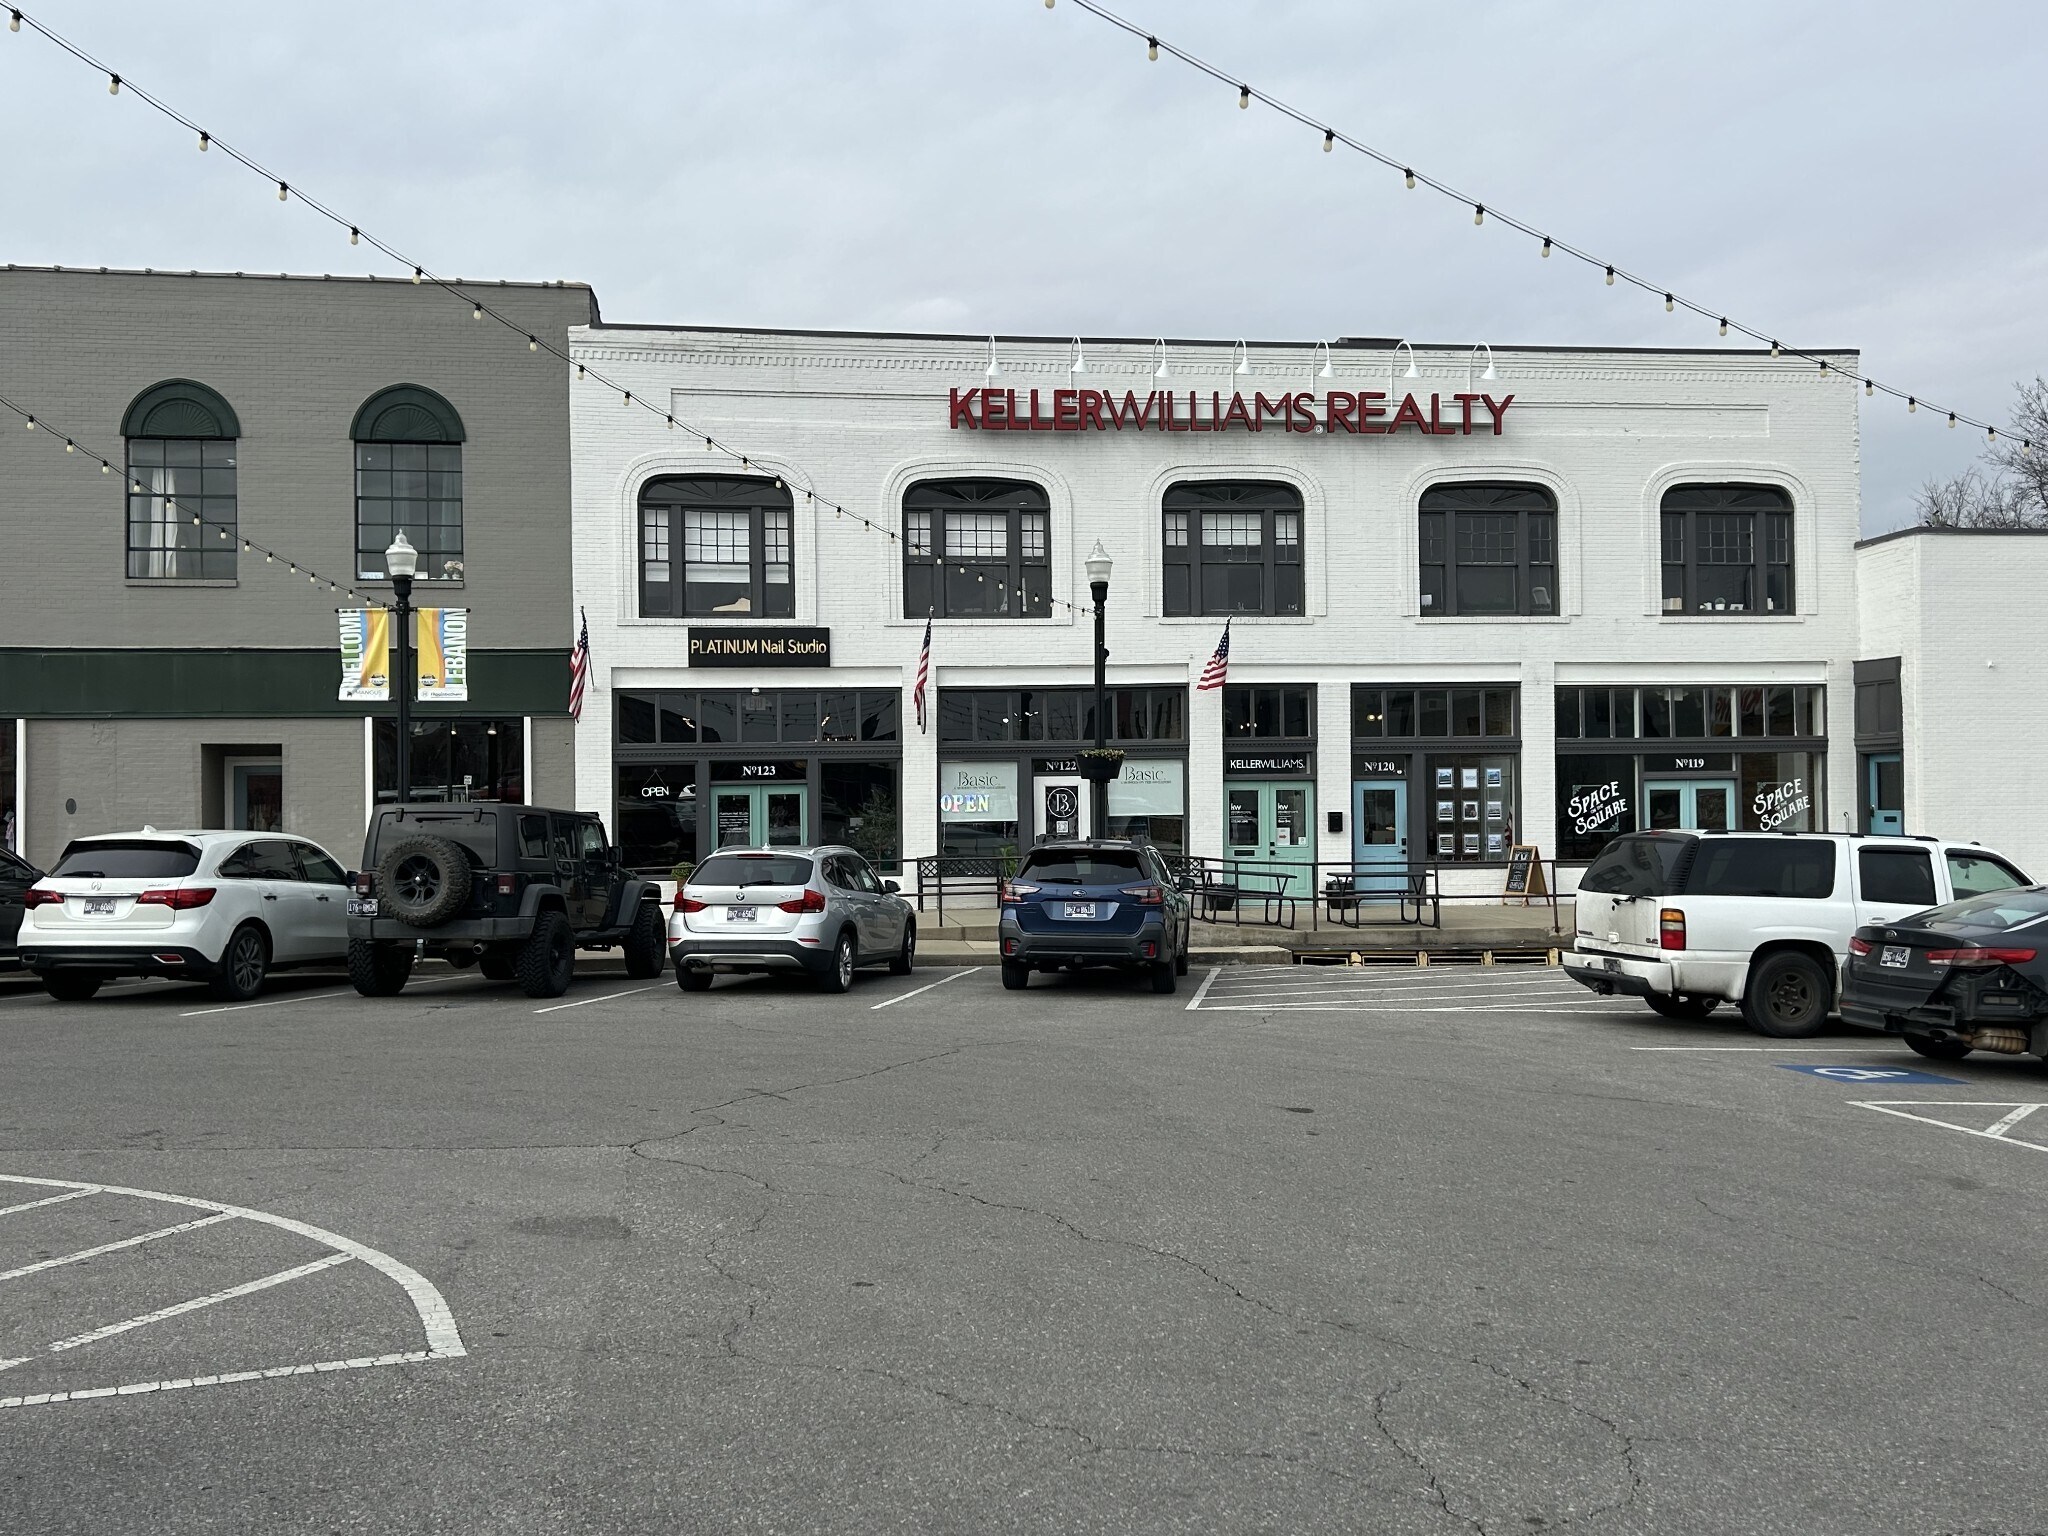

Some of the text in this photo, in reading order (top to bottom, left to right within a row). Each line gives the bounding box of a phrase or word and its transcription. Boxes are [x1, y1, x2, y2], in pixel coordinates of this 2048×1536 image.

[1326, 391, 1515, 435] REALTY
[339, 609, 363, 688] WELCOME
[443, 608, 467, 688] LEBANON
[690, 638, 827, 654] PLATINUM Nail Studio
[641, 786, 670, 797] OPEN
[940, 794, 989, 812] OPEN
[1568, 781, 1620, 818] SPACE
[1753, 779, 1802, 814] SPACE
[1575, 799, 1628, 834] SQUARE
[1760, 796, 1810, 831] SQUARE
